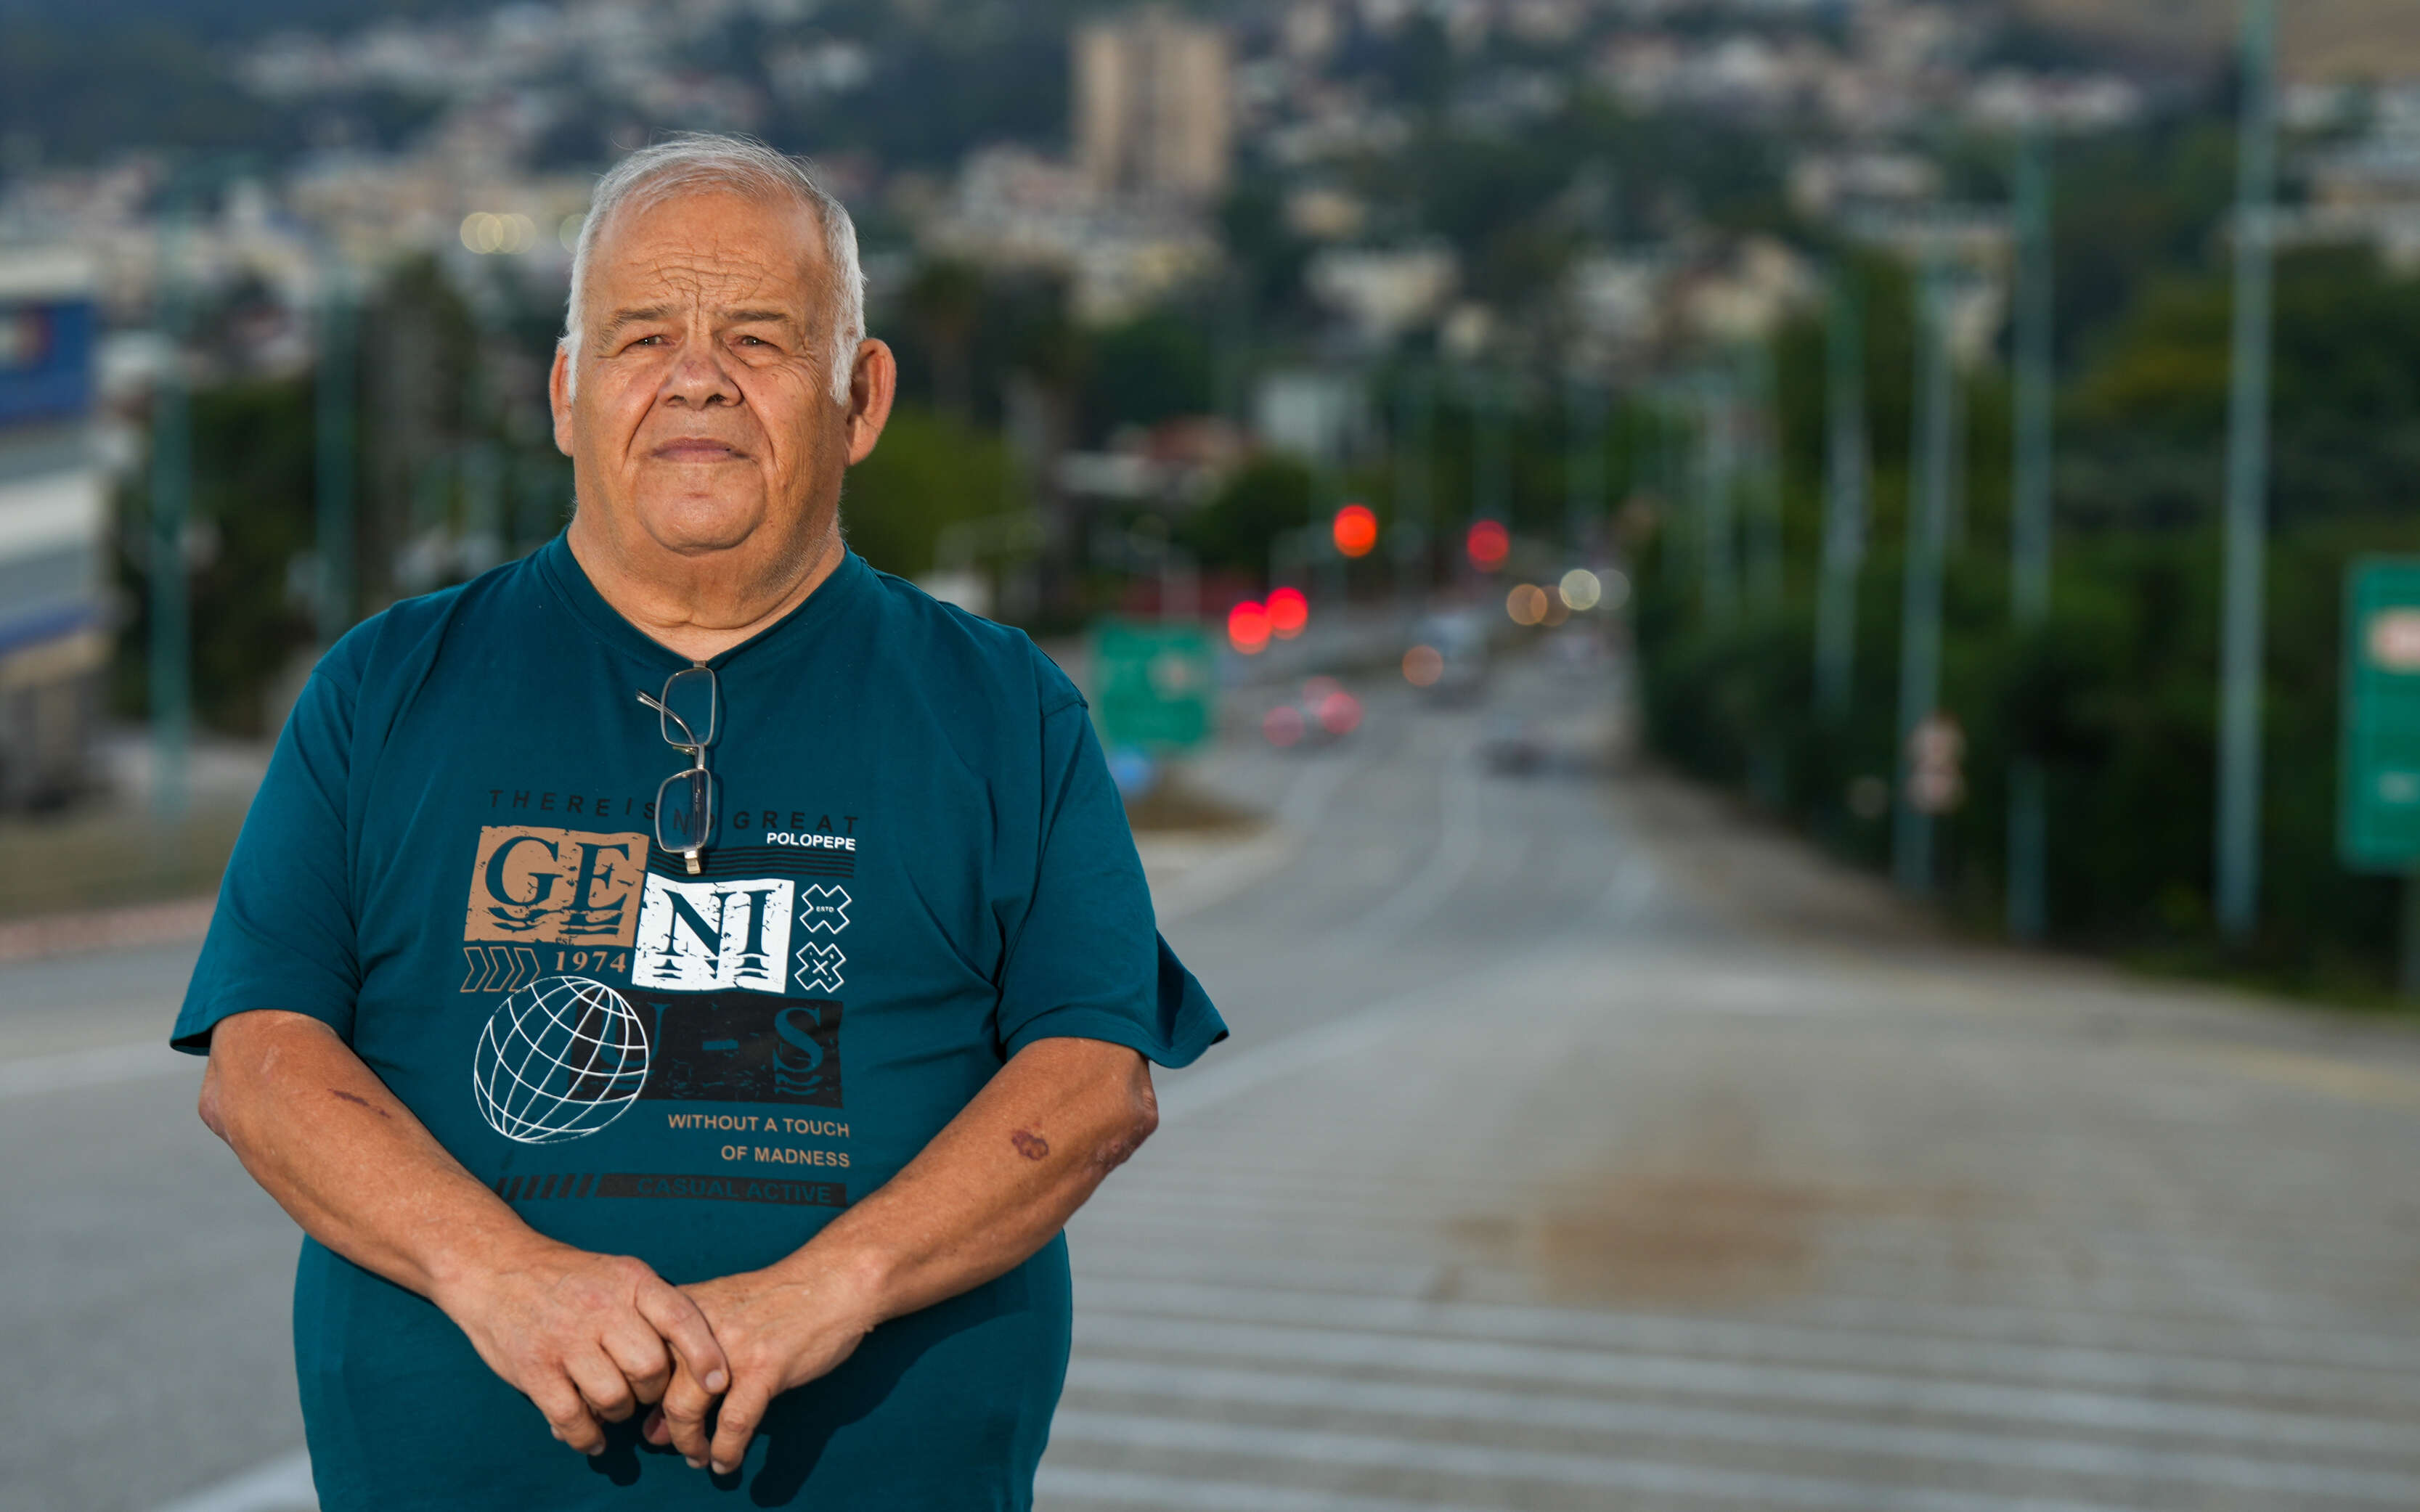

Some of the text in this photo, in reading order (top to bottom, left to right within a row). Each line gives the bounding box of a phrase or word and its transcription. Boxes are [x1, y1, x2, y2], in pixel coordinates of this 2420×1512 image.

[733, 811, 859, 835] GREAT
[766, 832, 856, 851] POLOPEPE
[485, 835, 777, 980] GE NI
[555, 951, 626, 973] 1974
[667, 1113, 850, 1138] WITHOUT A TOUCH
[721, 1145, 851, 1168] OF MADNESS
[637, 1177, 831, 1204] CASUAL ACTIVE
